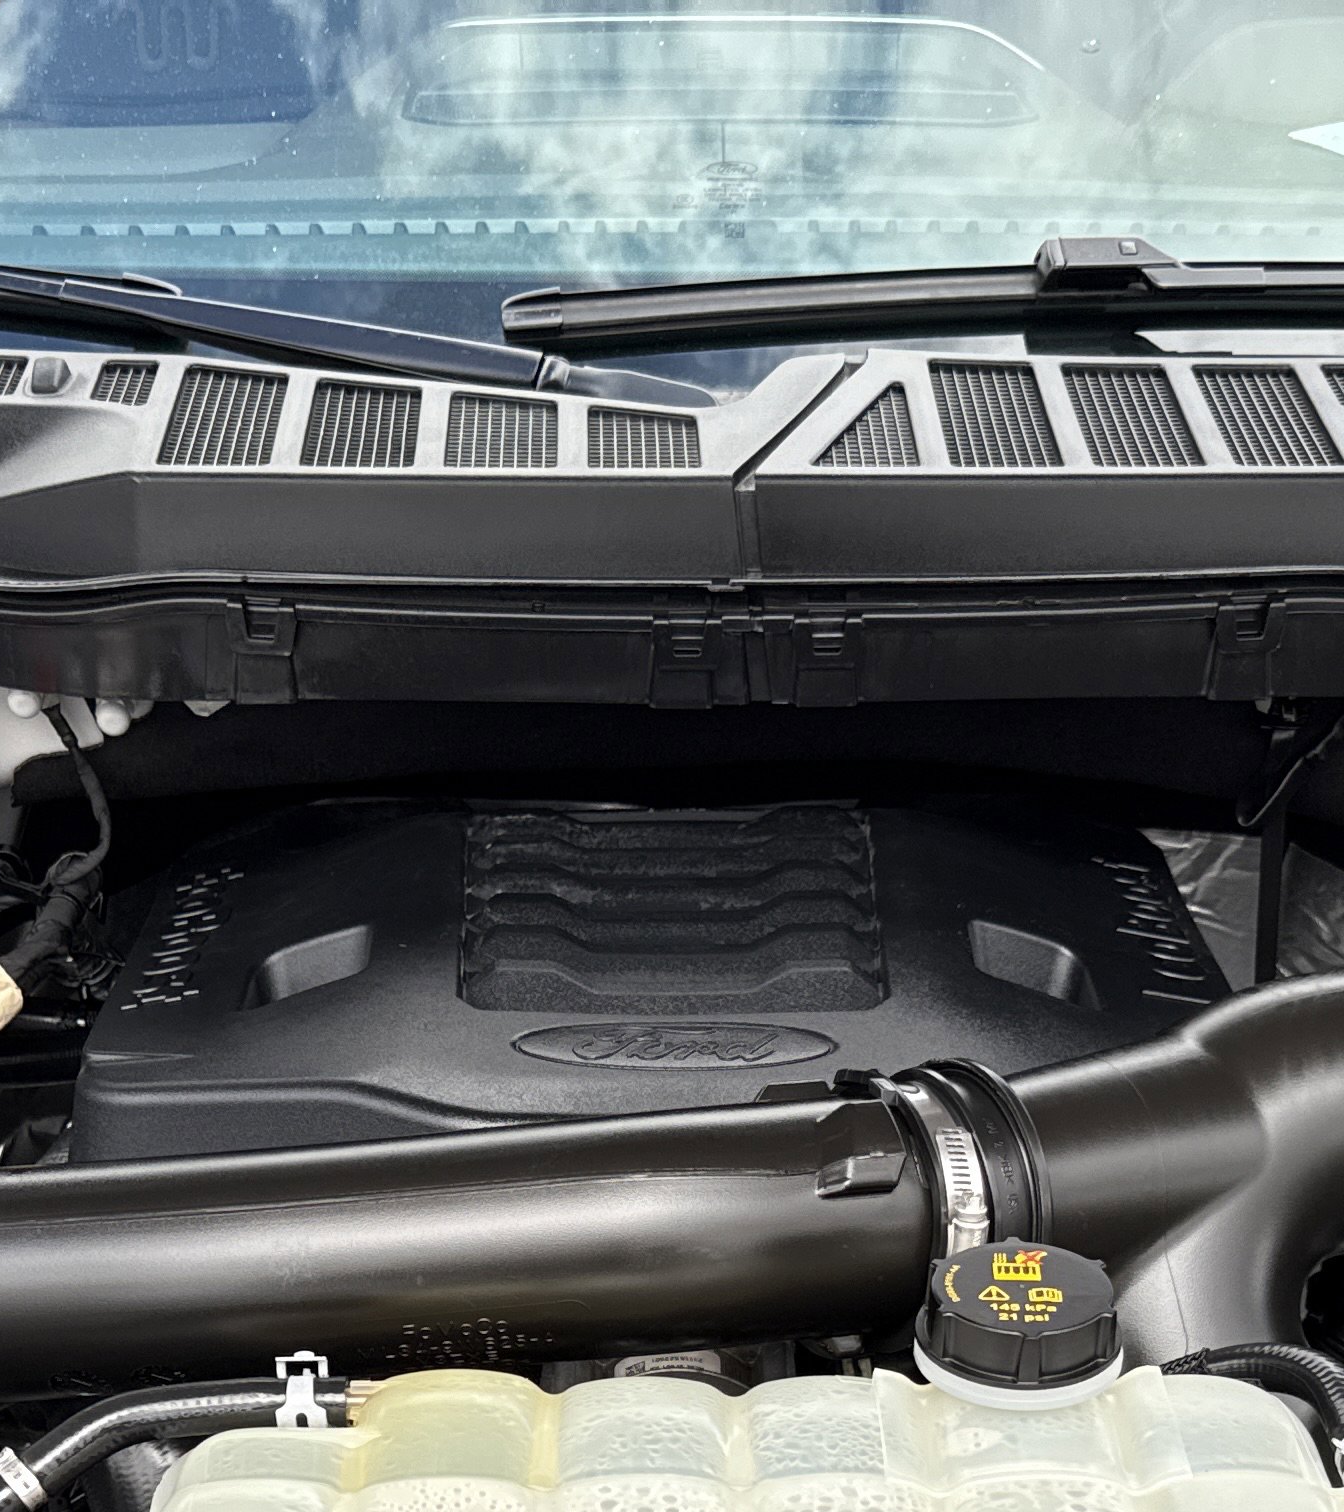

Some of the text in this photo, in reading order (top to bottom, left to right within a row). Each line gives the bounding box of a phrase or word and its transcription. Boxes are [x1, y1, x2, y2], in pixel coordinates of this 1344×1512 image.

[571, 1025, 778, 1062] Ford
[998, 1312, 1050, 1323] 21 psi
